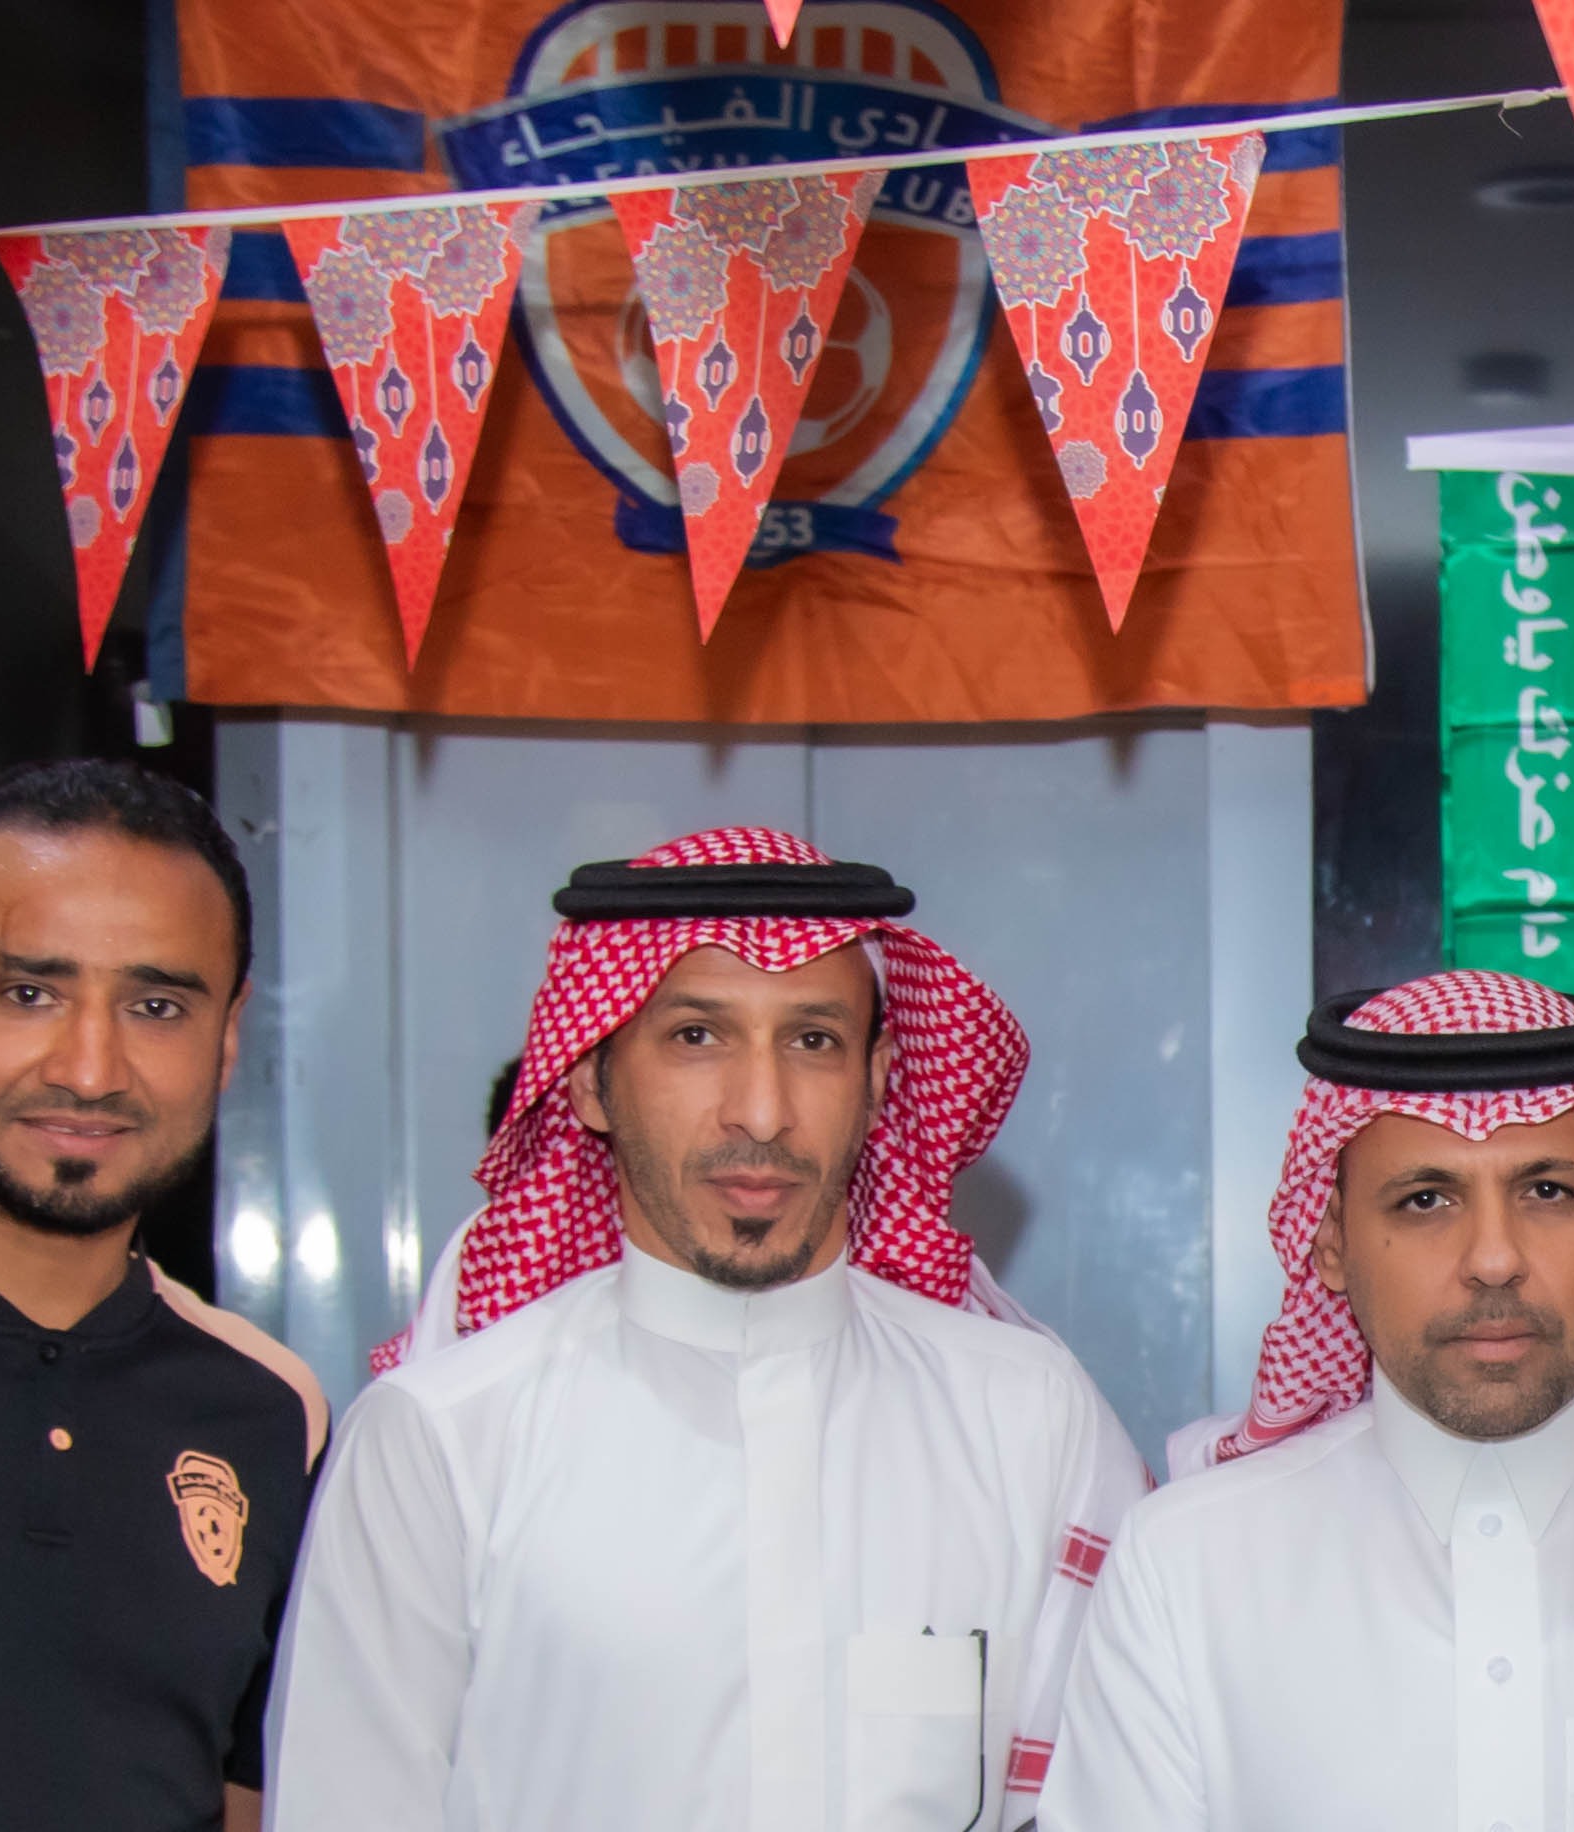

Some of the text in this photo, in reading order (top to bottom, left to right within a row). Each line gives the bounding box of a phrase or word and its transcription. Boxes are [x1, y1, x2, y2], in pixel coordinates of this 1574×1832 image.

[501, 80, 816, 167] الفيحاء
[1504, 687, 1572, 851] عزك
[1502, 868, 1569, 960] دام
